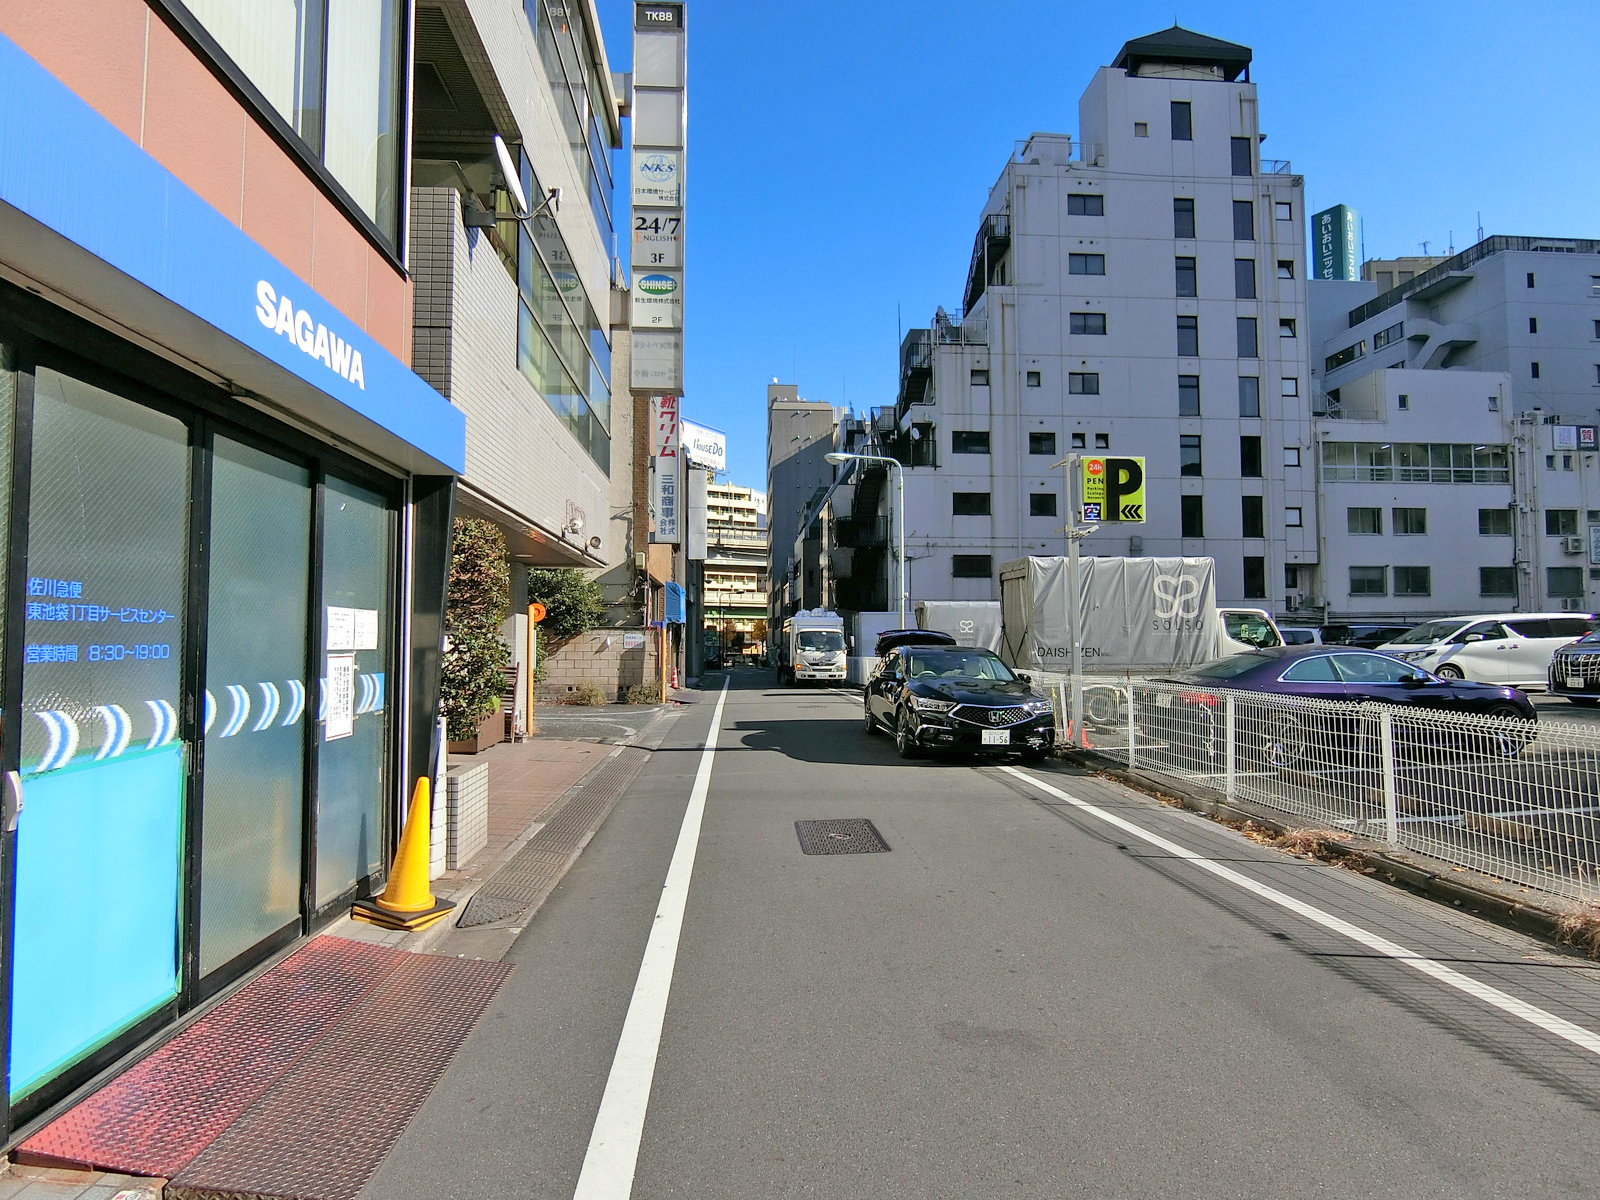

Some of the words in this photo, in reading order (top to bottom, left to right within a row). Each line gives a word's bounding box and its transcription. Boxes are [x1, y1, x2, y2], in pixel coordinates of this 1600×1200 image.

[645, 11, 673, 22] TK88
[640, 163, 676, 173] NKS
[635, 217, 681, 235] 24/7
[650, 253, 665, 264] 3F
[640, 280, 676, 290] SHINSEI
[651, 316, 663, 324] 2F
[255, 280, 366, 391] SAGAWA
[1088, 463, 1103, 471] 24h
[1086, 477, 1104, 485] PEN
[1105, 458, 1143, 521] P
[28, 577, 83, 599] 佐川急便
[25, 645, 78, 664] 営業時間
[1037, 646, 1101, 658] DAISHZEN
[988, 735, 1009, 744] 11-56
